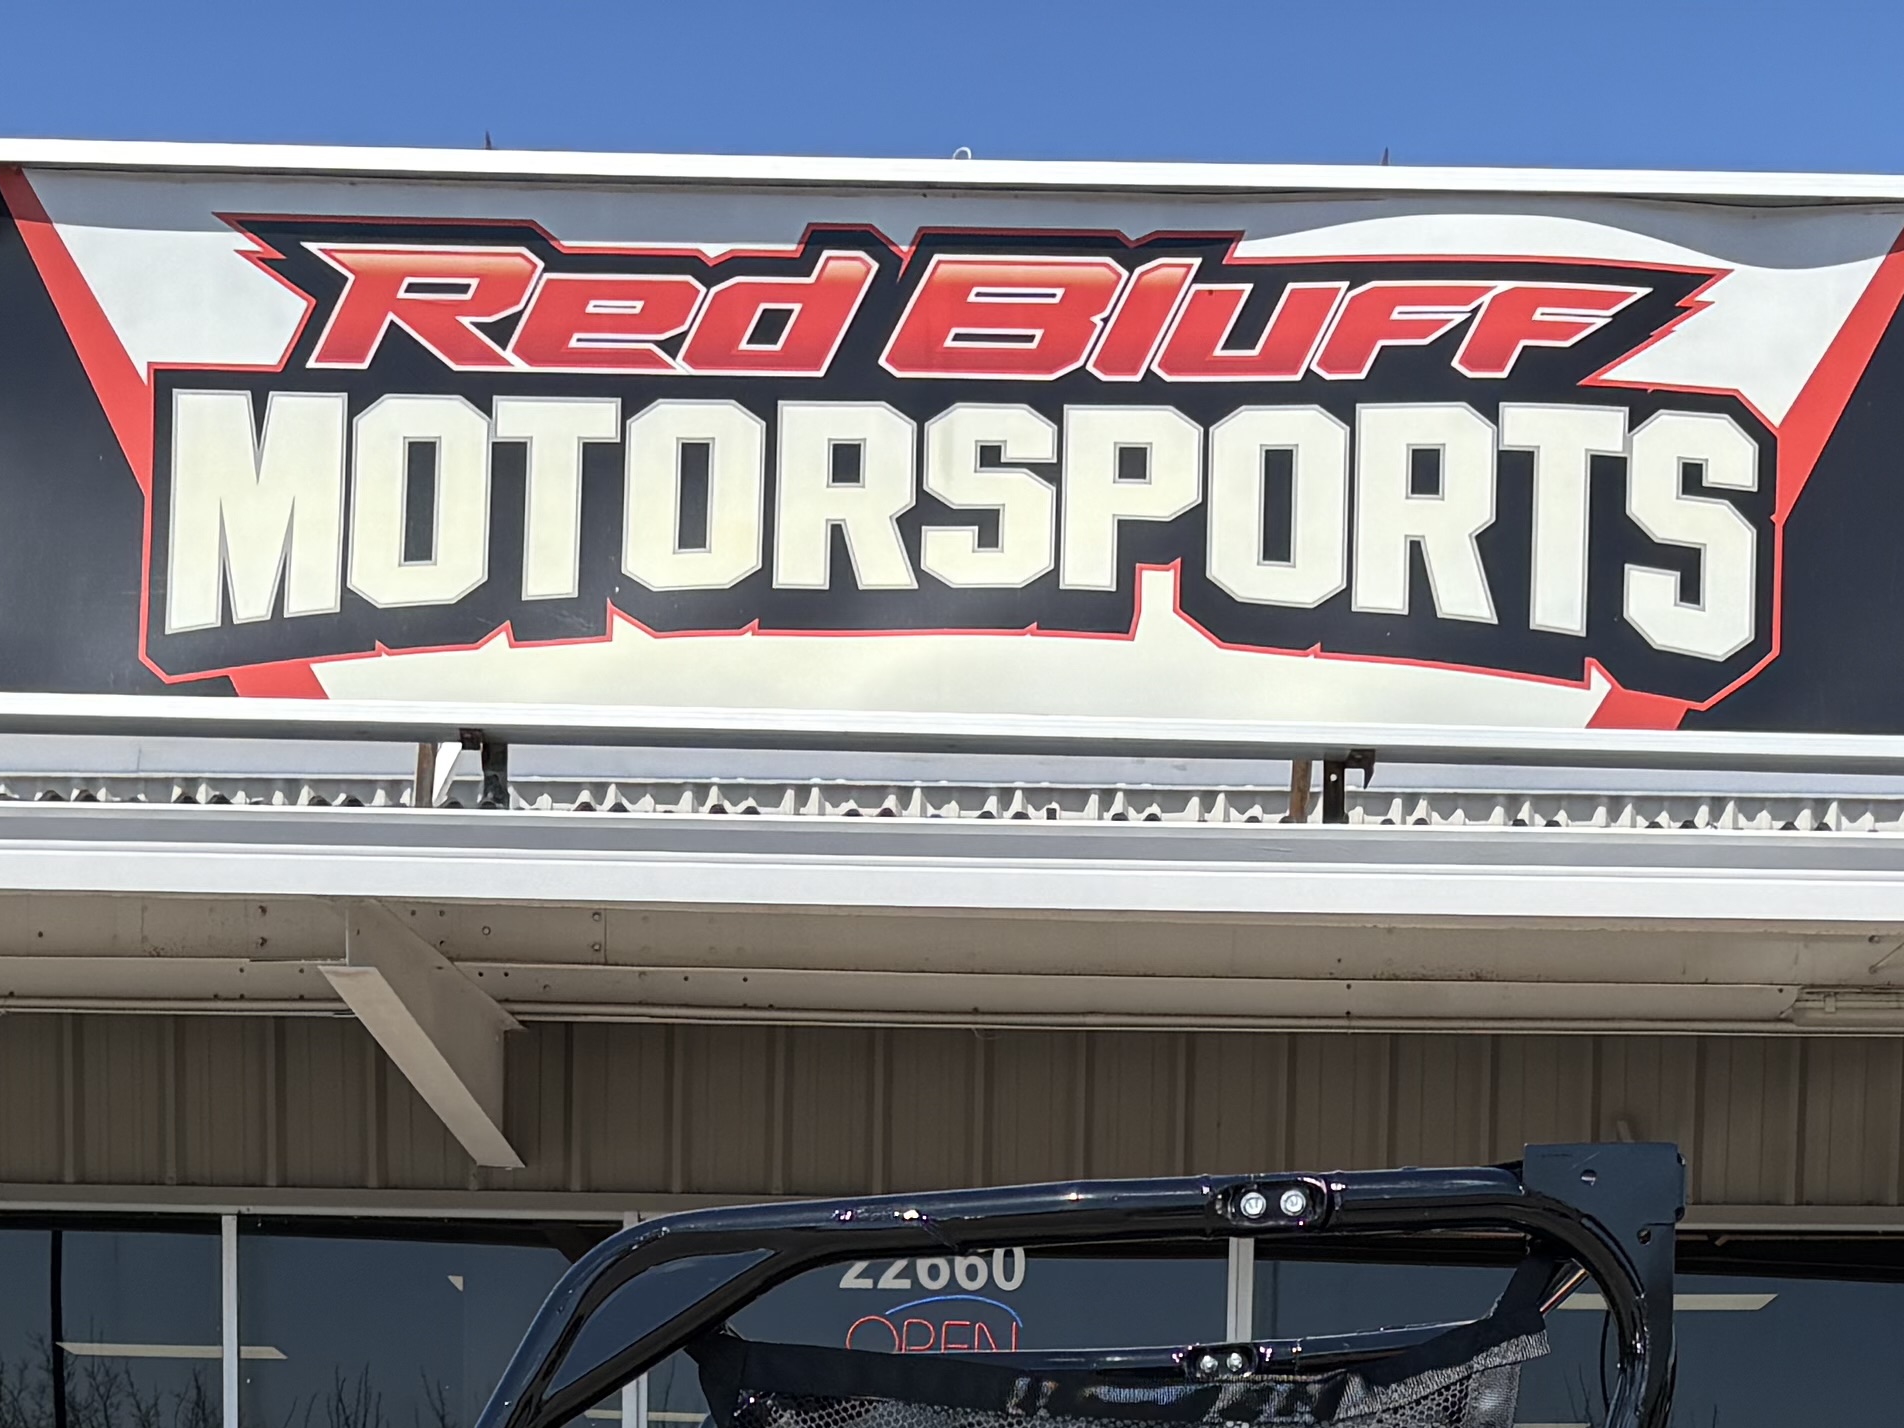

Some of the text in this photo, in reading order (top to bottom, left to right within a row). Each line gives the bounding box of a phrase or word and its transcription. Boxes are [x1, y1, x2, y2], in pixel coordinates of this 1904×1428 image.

[302, 242, 878, 377] Red
[163, 387, 1758, 664] MOTORSPORTS
[839, 1247, 1026, 1291] 22660
[846, 1315, 1019, 1353] OPEN
